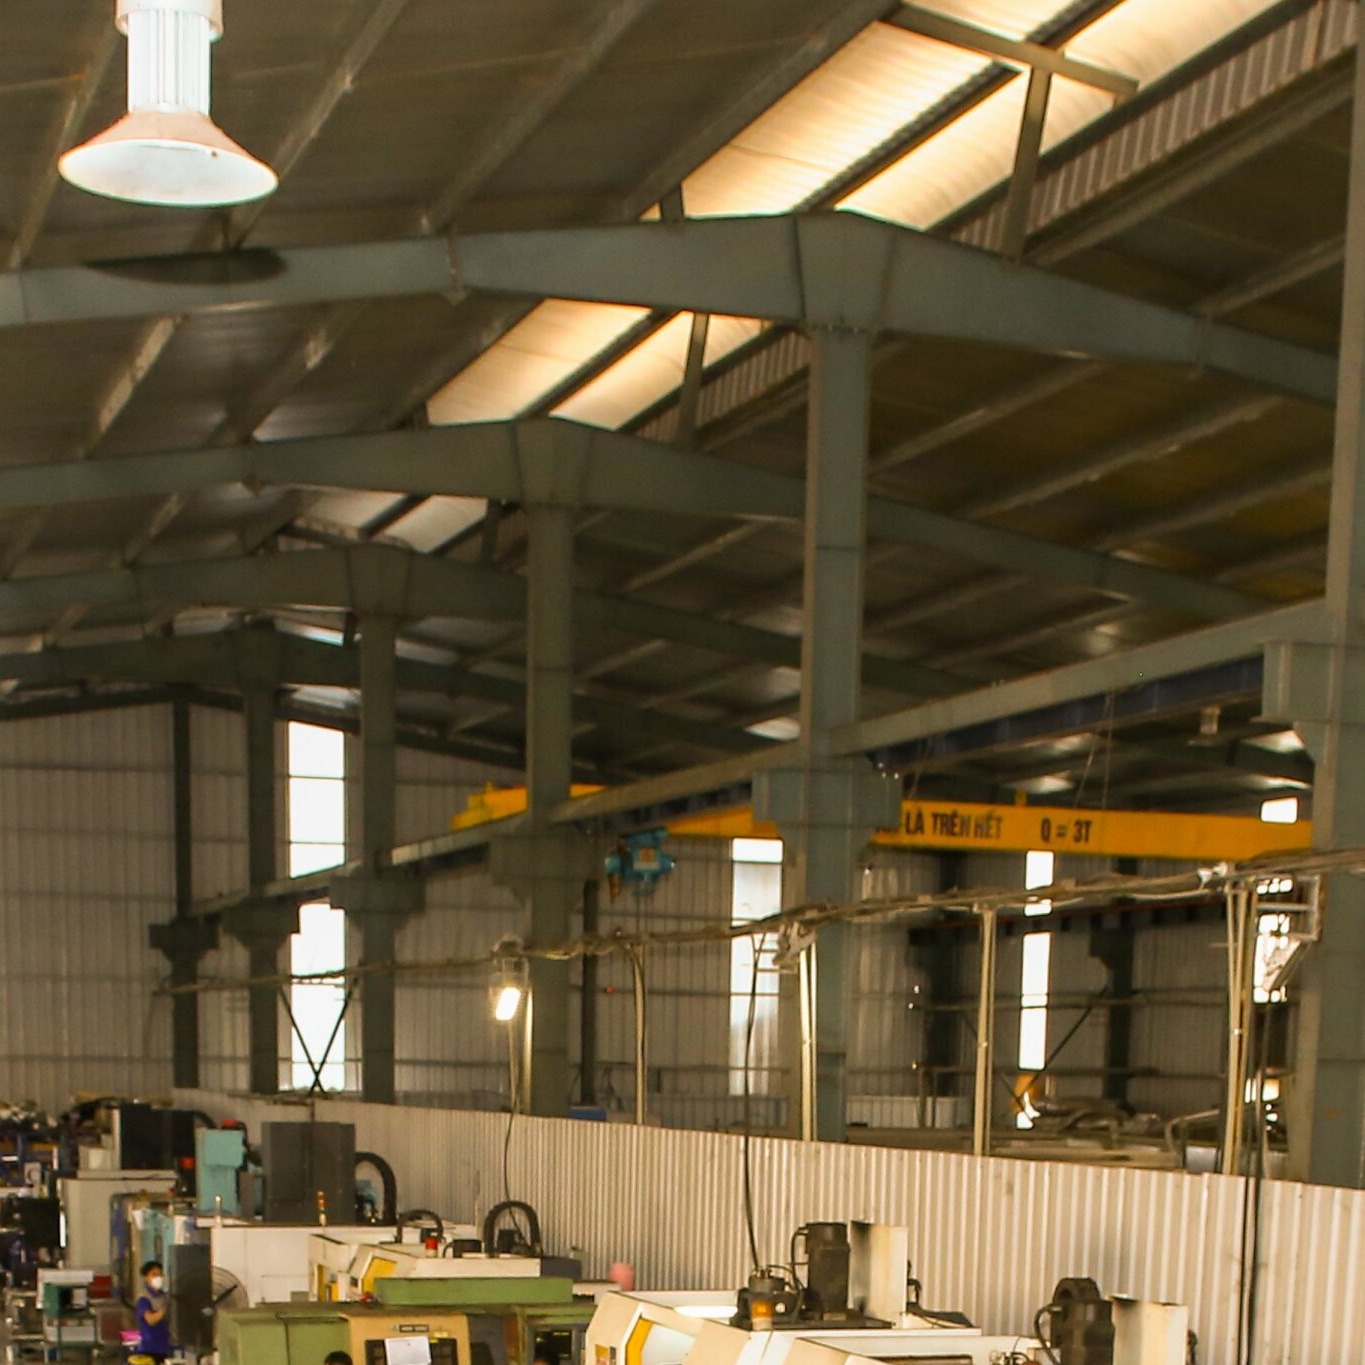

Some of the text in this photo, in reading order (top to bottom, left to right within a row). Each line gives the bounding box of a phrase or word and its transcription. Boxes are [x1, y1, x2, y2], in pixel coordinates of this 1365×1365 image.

[905, 808, 925, 835] LÀ
[932, 810, 970, 837] TRÊN
[1041, 817, 1052, 843] Q
[1074, 819, 1092, 843] 3T
